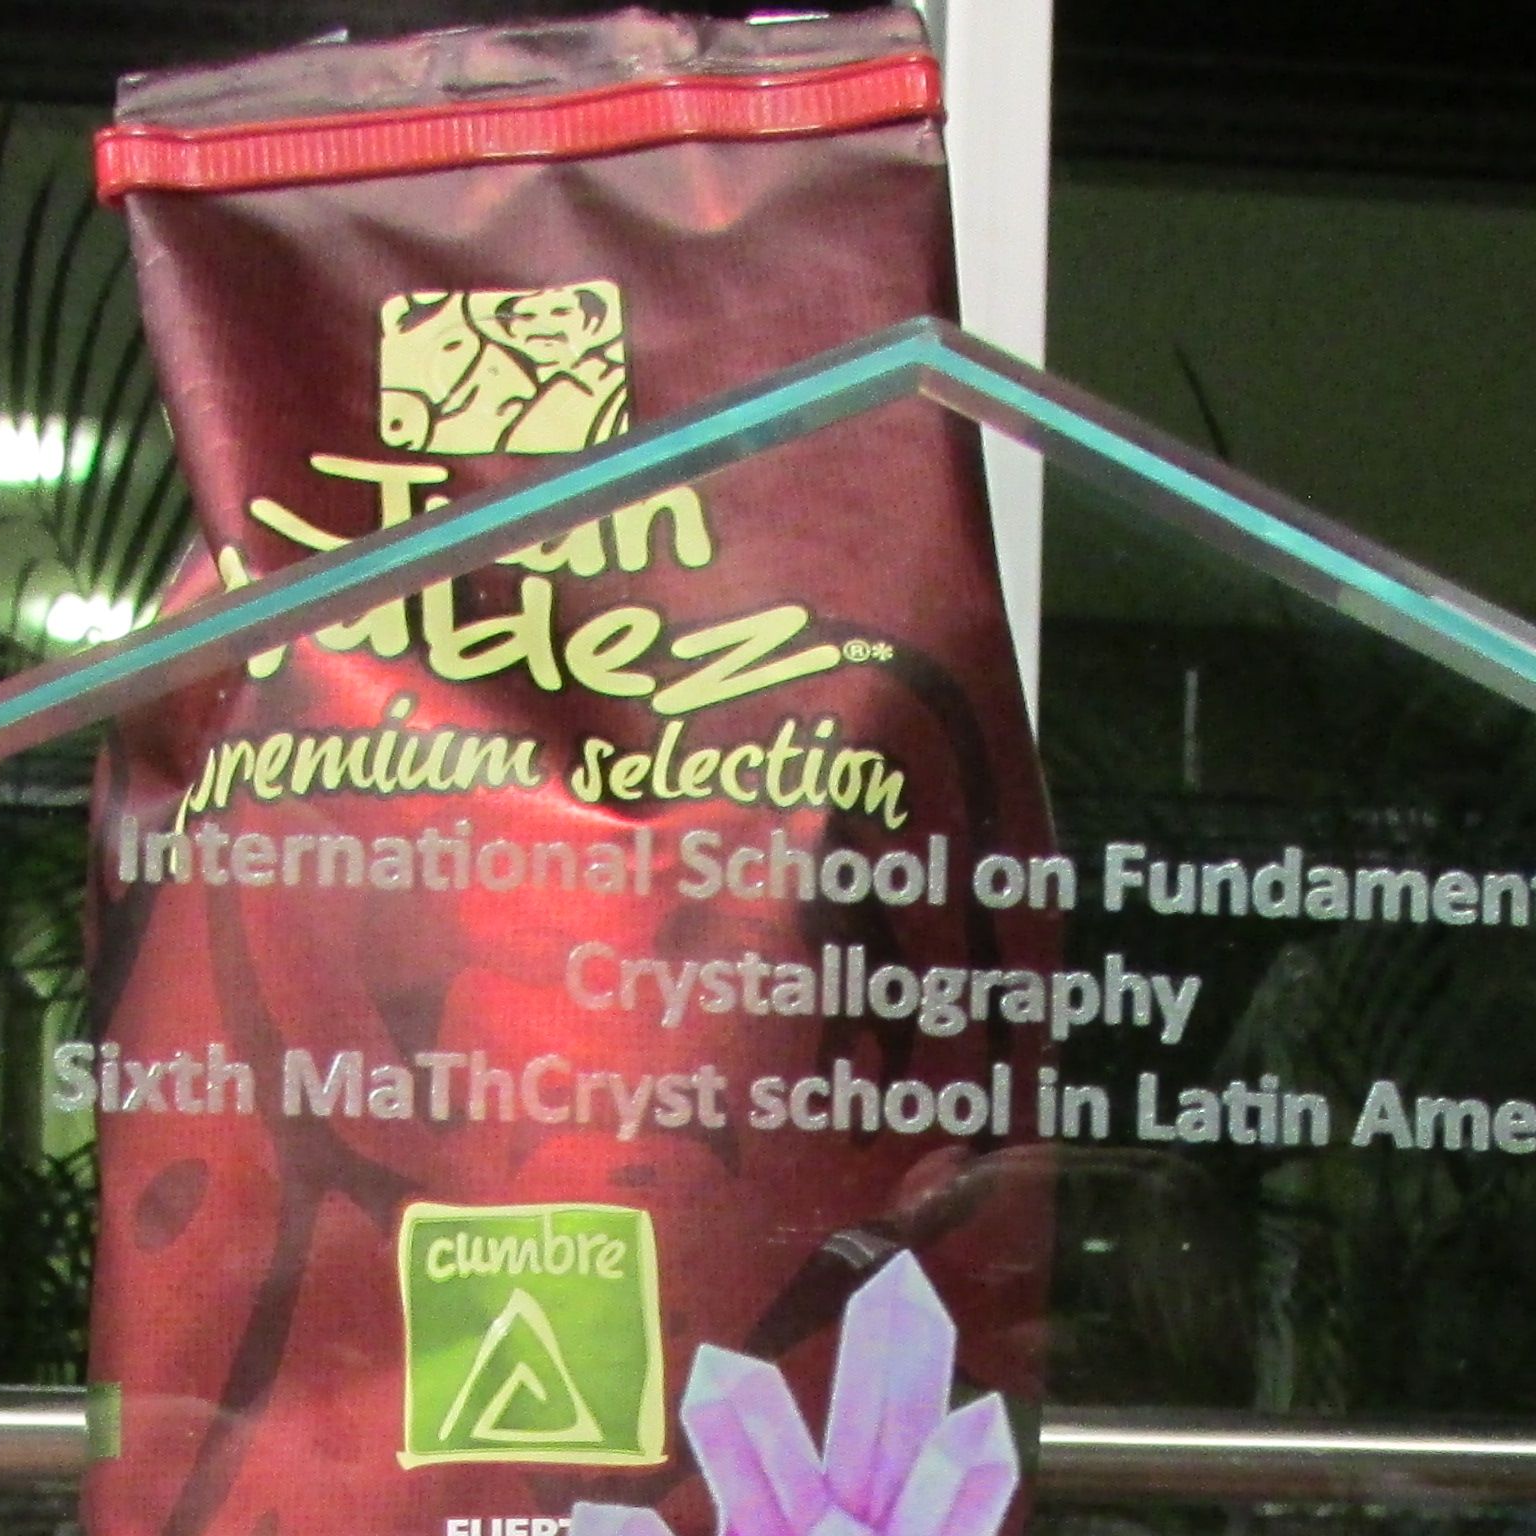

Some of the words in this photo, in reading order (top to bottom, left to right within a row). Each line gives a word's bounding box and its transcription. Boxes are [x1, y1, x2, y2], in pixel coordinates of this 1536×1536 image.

[250, 453, 712, 577] Jan
[172, 697, 538, 873] premium
[570, 721, 909, 827] selection
[117, 820, 653, 897] International
[677, 828, 947, 907] School
[971, 851, 1078, 910] on
[564, 942, 1203, 1044] Crystallography
[50, 1042, 256, 1116] Sixth
[282, 1047, 729, 1141] MaThCryst
[747, 1059, 1011, 1138] school
[1036, 1066, 1111, 1141] in
[1136, 1073, 1331, 1148] Latin
[426, 1216, 628, 1284] cumbre
